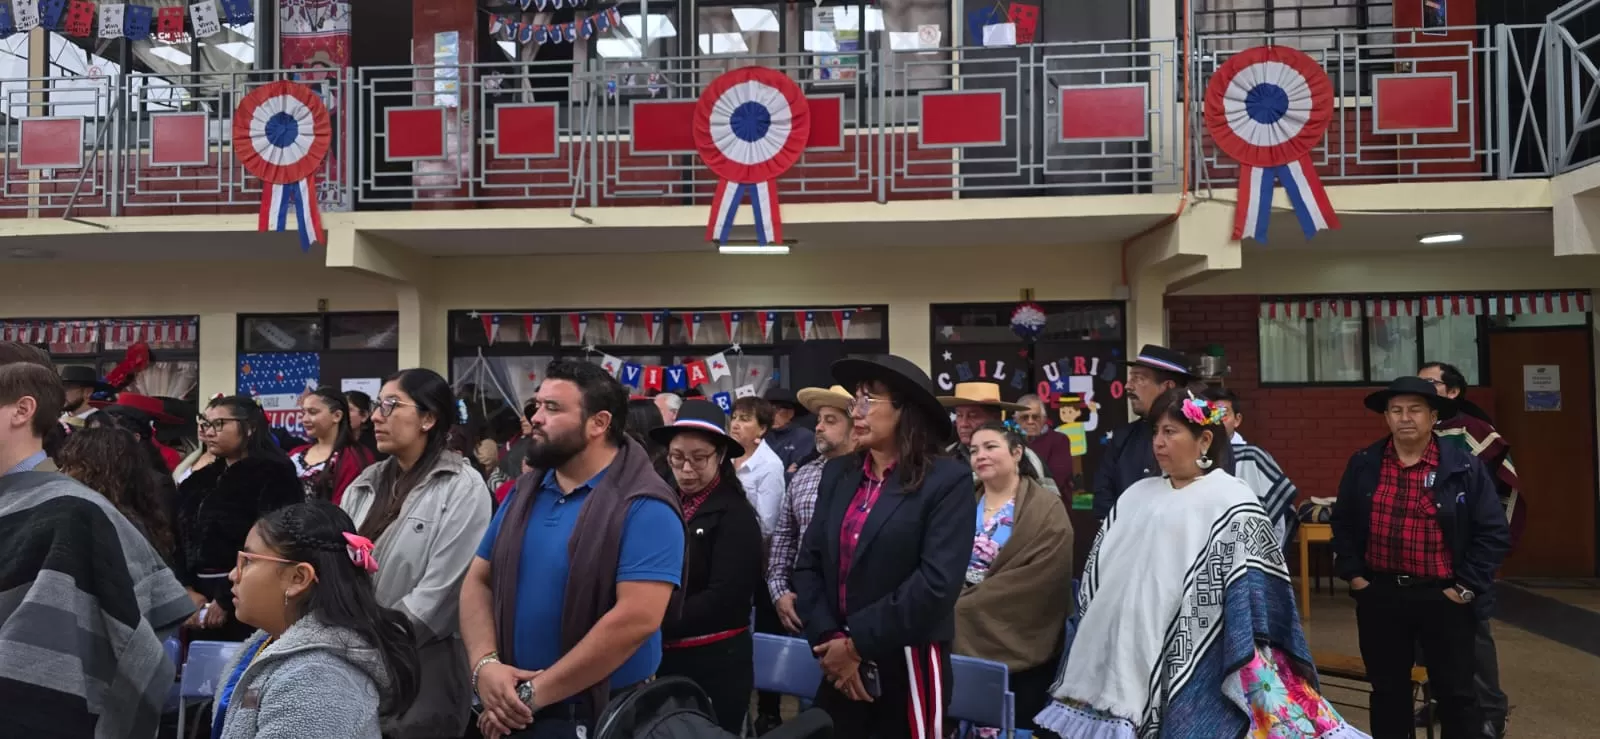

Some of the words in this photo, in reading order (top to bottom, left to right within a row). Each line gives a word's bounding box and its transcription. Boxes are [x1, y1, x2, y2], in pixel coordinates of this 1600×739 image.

[196, 24, 218, 36] CHILE
[199, 20, 214, 28] VIVA
[626, 365, 704, 384] VIVA
[938, 360, 1026, 390] CHILE
